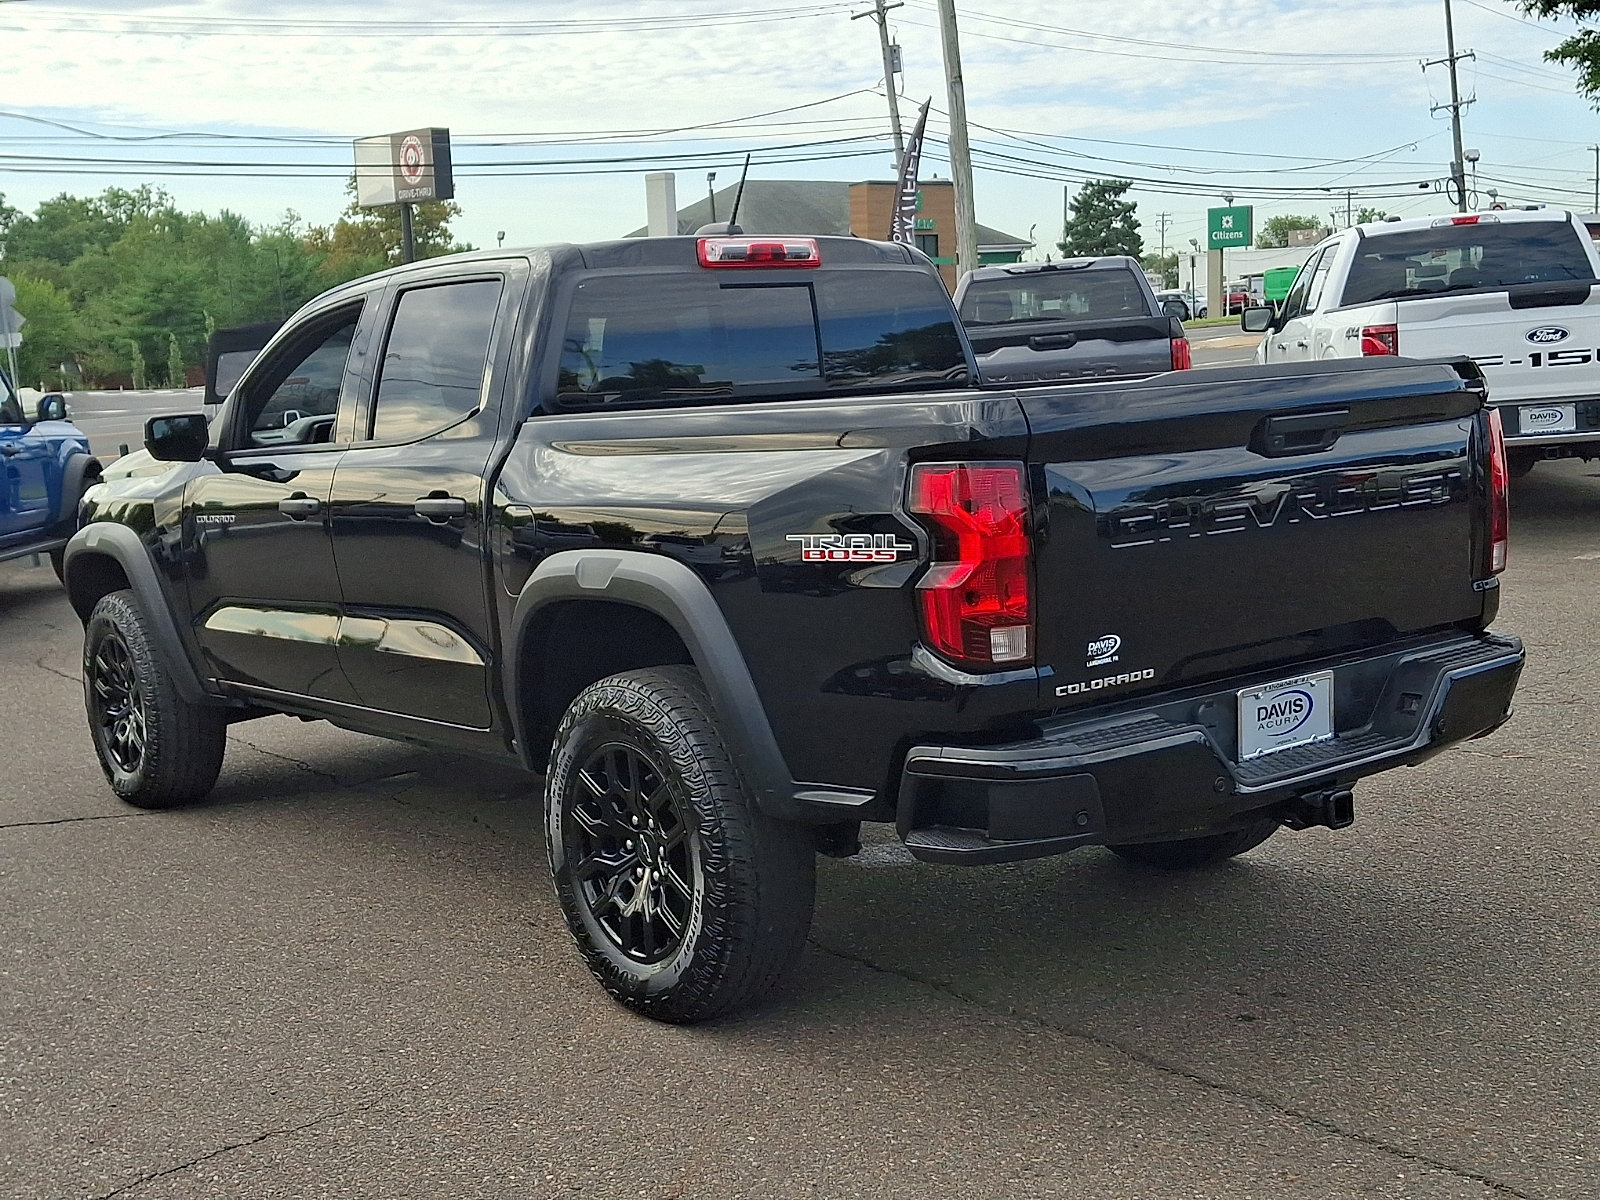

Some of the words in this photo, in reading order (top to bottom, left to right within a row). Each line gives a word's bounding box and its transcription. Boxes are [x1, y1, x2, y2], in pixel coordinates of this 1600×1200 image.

[1212, 231, 1244, 240] Citizens
[1533, 328, 1562, 342] Ford
[1470, 348, 1600, 368] F-15
[1530, 412, 1558, 420] DAVIS
[1110, 472, 1461, 549] CHEVROLET
[195, 514, 236, 524] COLORADO
[786, 534, 912, 550] TRAIL
[802, 548, 897, 562] BOSS
[1088, 638, 1115, 651] DAVIS
[1055, 668, 1155, 697] COLORADO
[1257, 697, 1304, 722] DAVIS
[1257, 715, 1300, 731] ACURA
[683, 888, 700, 959] TERRITORY
